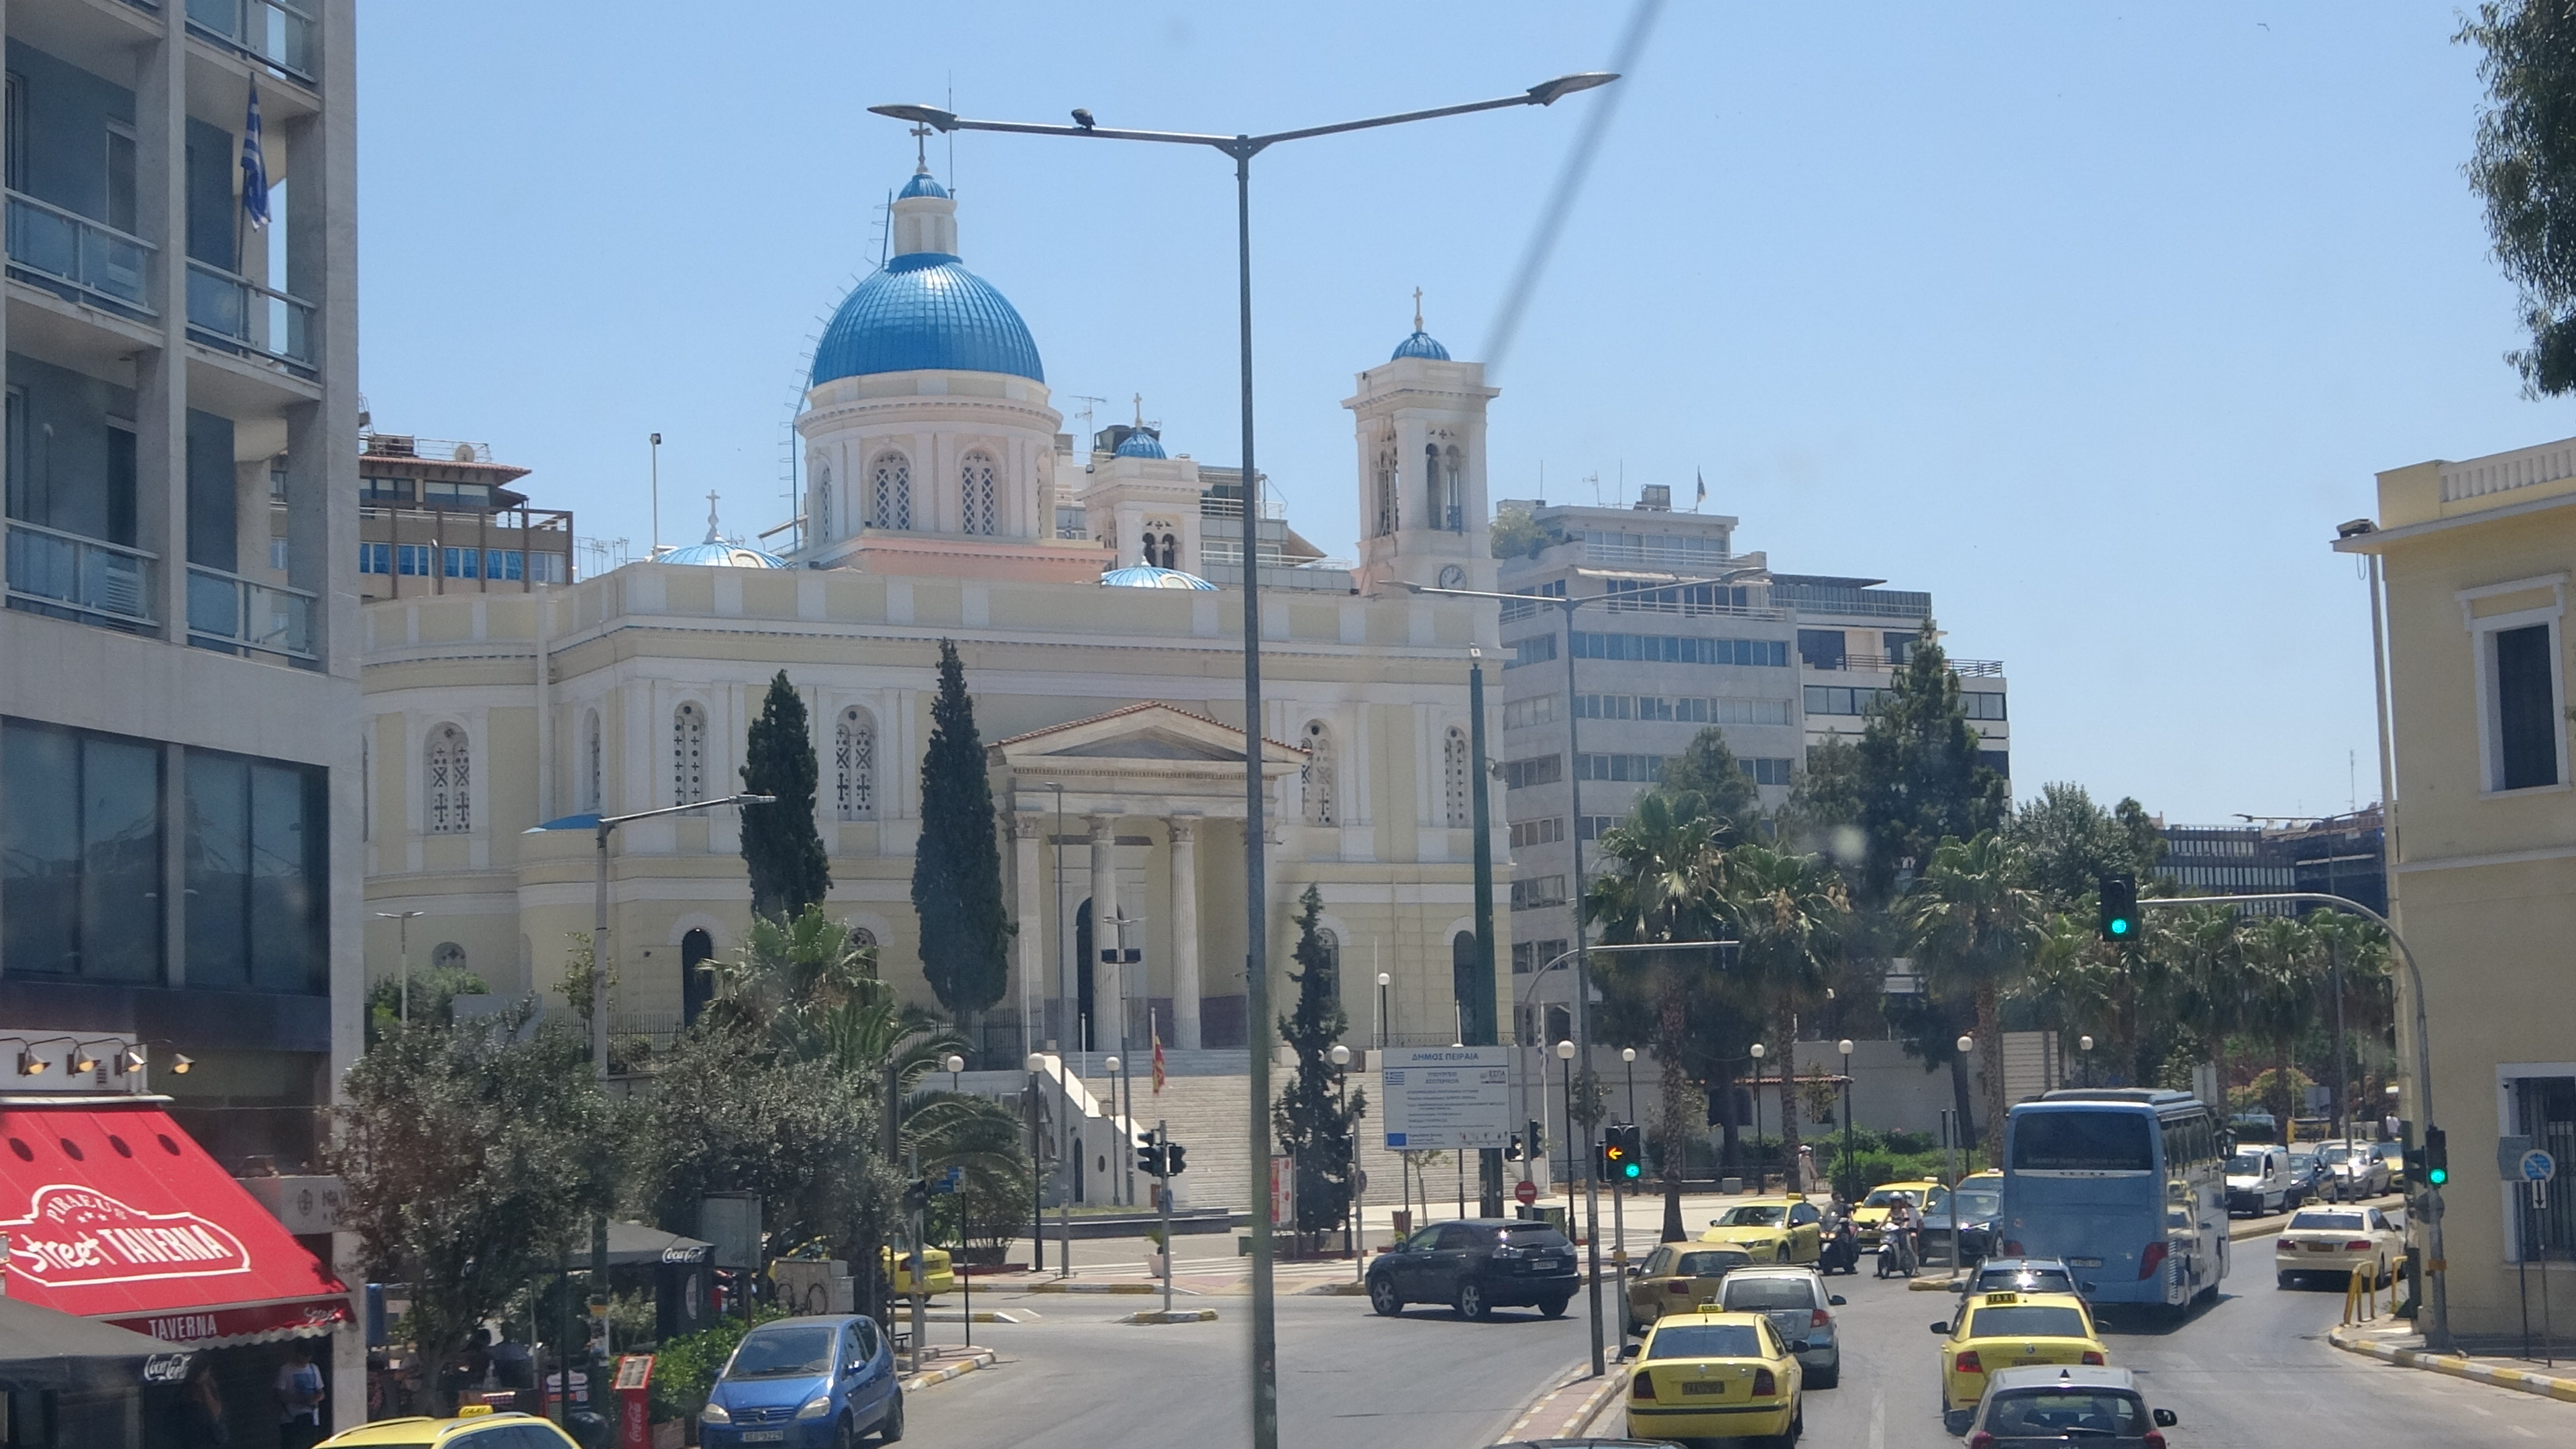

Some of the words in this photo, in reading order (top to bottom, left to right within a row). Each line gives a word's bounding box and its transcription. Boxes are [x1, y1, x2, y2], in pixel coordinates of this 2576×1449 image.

[1445, 1053, 1479, 1061] ΠΕΙΡΑΙΑ
[96, 1224, 233, 1264] TAVERNA
[148, 1314, 218, 1340] TAVERNA
[461, 1407, 486, 1415] TAXI
